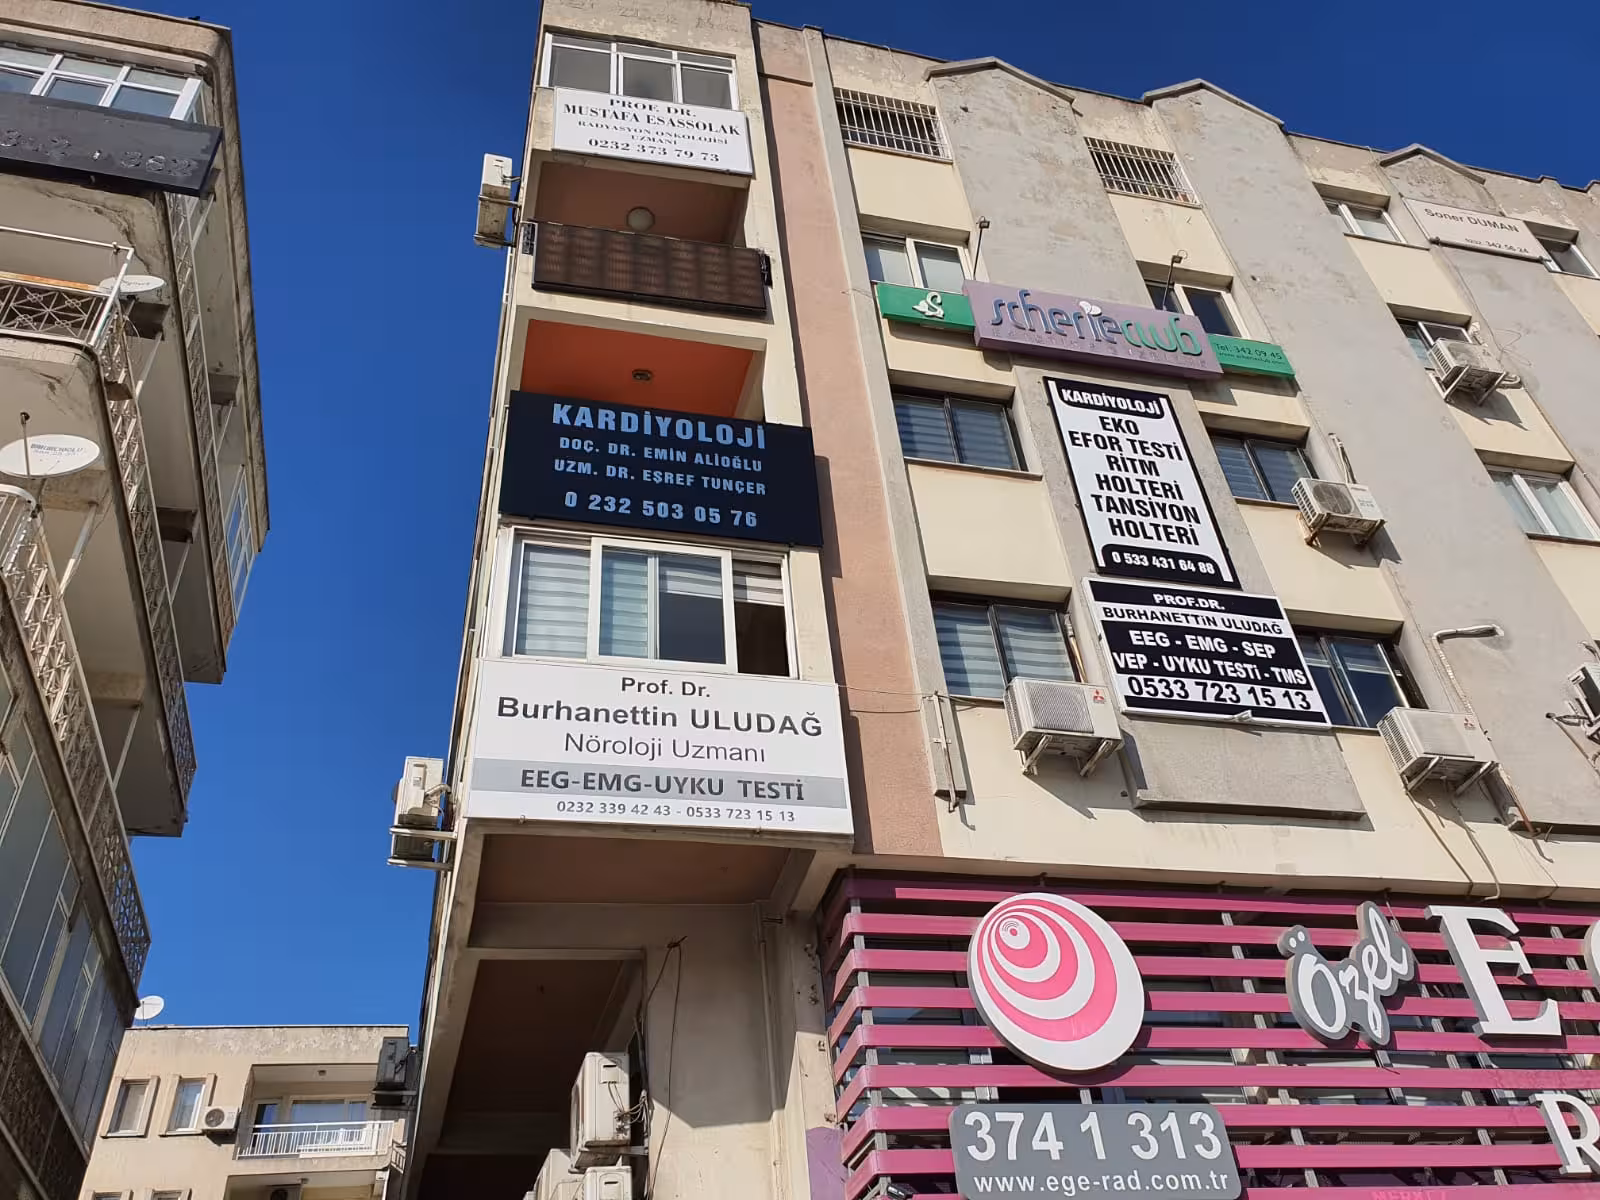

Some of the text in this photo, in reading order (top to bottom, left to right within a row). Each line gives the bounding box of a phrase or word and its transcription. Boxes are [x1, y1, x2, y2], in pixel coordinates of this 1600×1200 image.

[563, 103, 740, 136] MUSTAFA ESASSOLAK
[610, 98, 696, 117] PROF. DR.
[578, 120, 651, 135] RADYASYON
[588, 138, 720, 162] 0232 373 79 73
[1424, 208, 1520, 233] Soner DUMAN
[1234, 345, 1254, 356] 342
[1061, 388, 1161, 415] KARDİYOLOJİ
[551, 402, 766, 450] KARDİYOLOJİ
[1098, 415, 1140, 436] EKO
[559, 436, 763, 472] DOÇ. DR. EMİN ALİOĞLU
[1067, 430, 1183, 461] EFOR TESTİ
[554, 458, 767, 496] UZM. DR. EŞREF TUNÇER
[1105, 453, 1160, 477] RİTM
[1095, 473, 1184, 501] HOLTERİ
[565, 491, 757, 528] 0 232 503 05 76
[1091, 494, 1201, 525] TANSİYON
[1108, 517, 1200, 546] HOLTERİ
[1111, 551, 1121, 563] 0
[1123, 552, 1149, 567] 533
[1152, 555, 1176, 570] 431
[1179, 559, 1196, 573] 64
[1153, 593, 1226, 610] PROF.DR.
[1220, 617, 1283, 635] ULUDAĞ
[1128, 629, 1171, 648] EEG
[1184, 634, 1229, 653] EMG
[1241, 641, 1276, 659] SEP
[1112, 651, 1148, 670] VEP
[1161, 655, 1212, 675] UYKU
[1270, 667, 1307, 685] TMS
[621, 677, 710, 698] Prof. Dr.
[1127, 676, 1312, 710] 0533 723 15 13
[497, 696, 823, 737] Burhanettin ULUDAĞ
[564, 732, 765, 762] Nöroloji Uzmanı
[520, 769, 804, 801] EEG-EMG-UYKU TESTİ
[556, 800, 594, 813] 0232
[599, 802, 626, 814] 339
[631, 804, 649, 815] 42
[653, 805, 671, 816] 43
[686, 806, 721, 818] 0533
[726, 808, 751, 820] 723
[757, 809, 773, 821] 15
[779, 811, 795, 822] 13
[1289, 907, 1408, 1038] Özel
[963, 1111, 1223, 1162] 374 1 313
[973, 1169, 1228, 1196] www.ege-rad.com.tr
